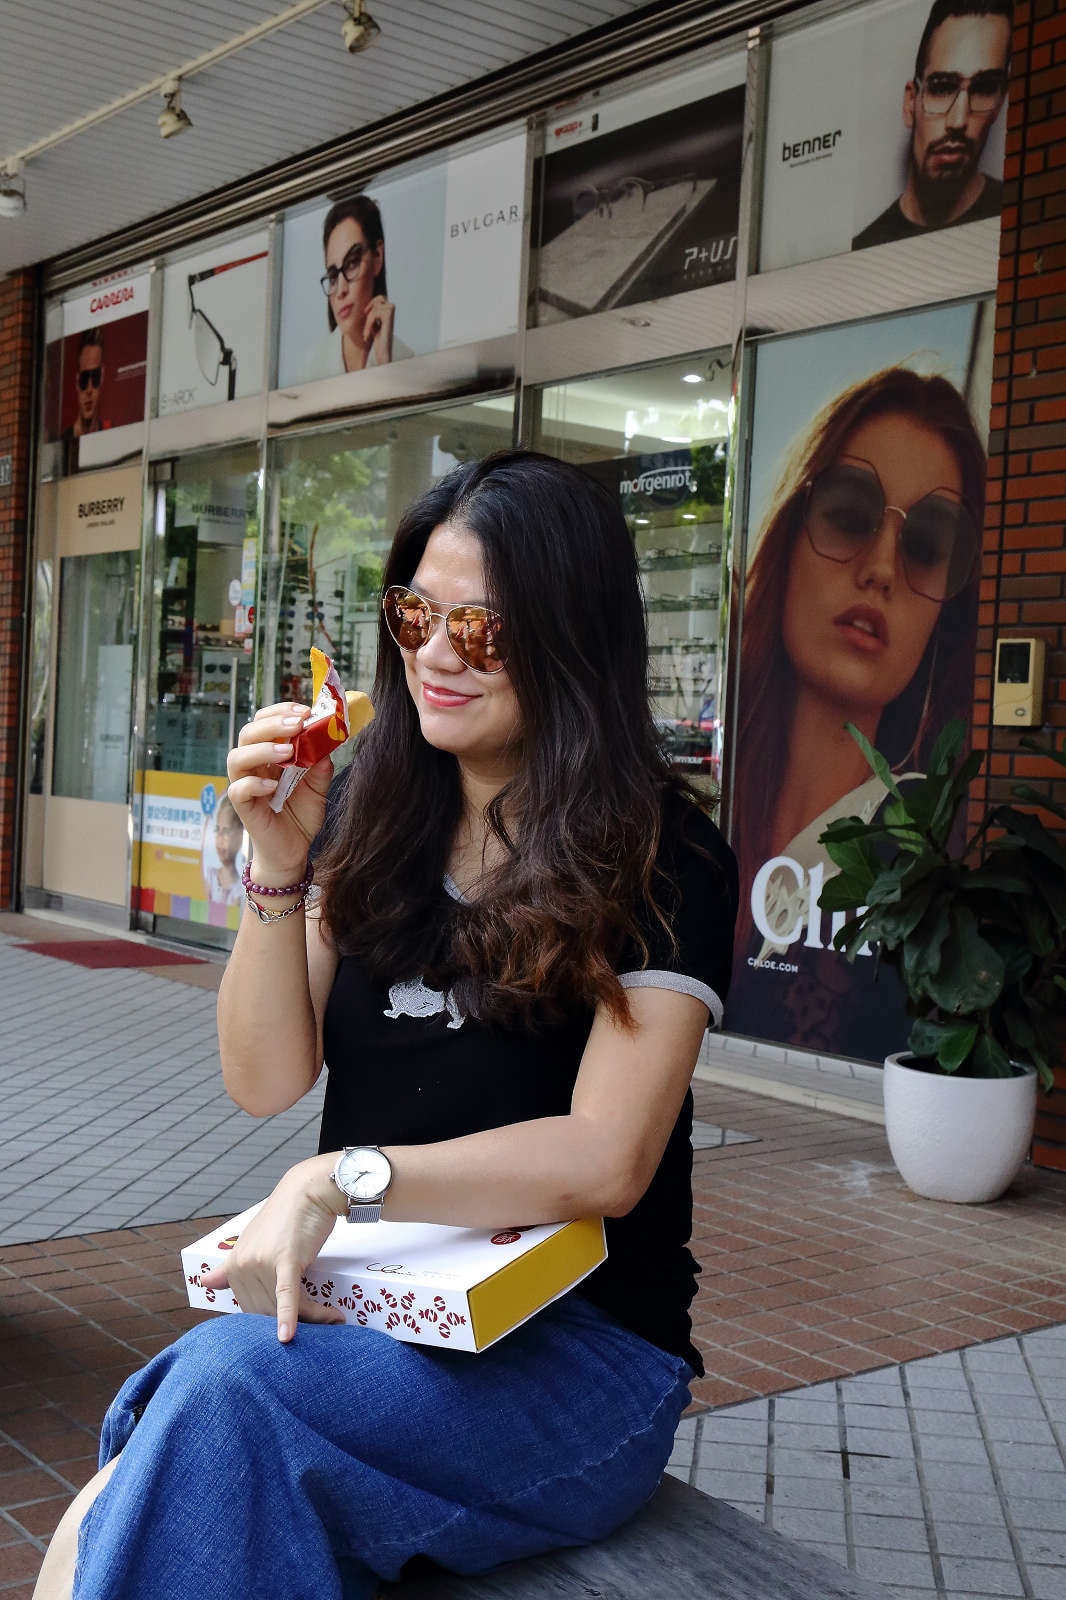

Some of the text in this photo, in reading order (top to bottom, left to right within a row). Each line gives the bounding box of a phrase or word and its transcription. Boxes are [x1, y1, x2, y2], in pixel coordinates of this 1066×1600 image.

[450, 204, 520, 239] BVLGAR
[90, 284, 134, 313] CARRERA
[78, 496, 125, 518] BURBERRY
[747, 957, 799, 973] CHLOE.COM
